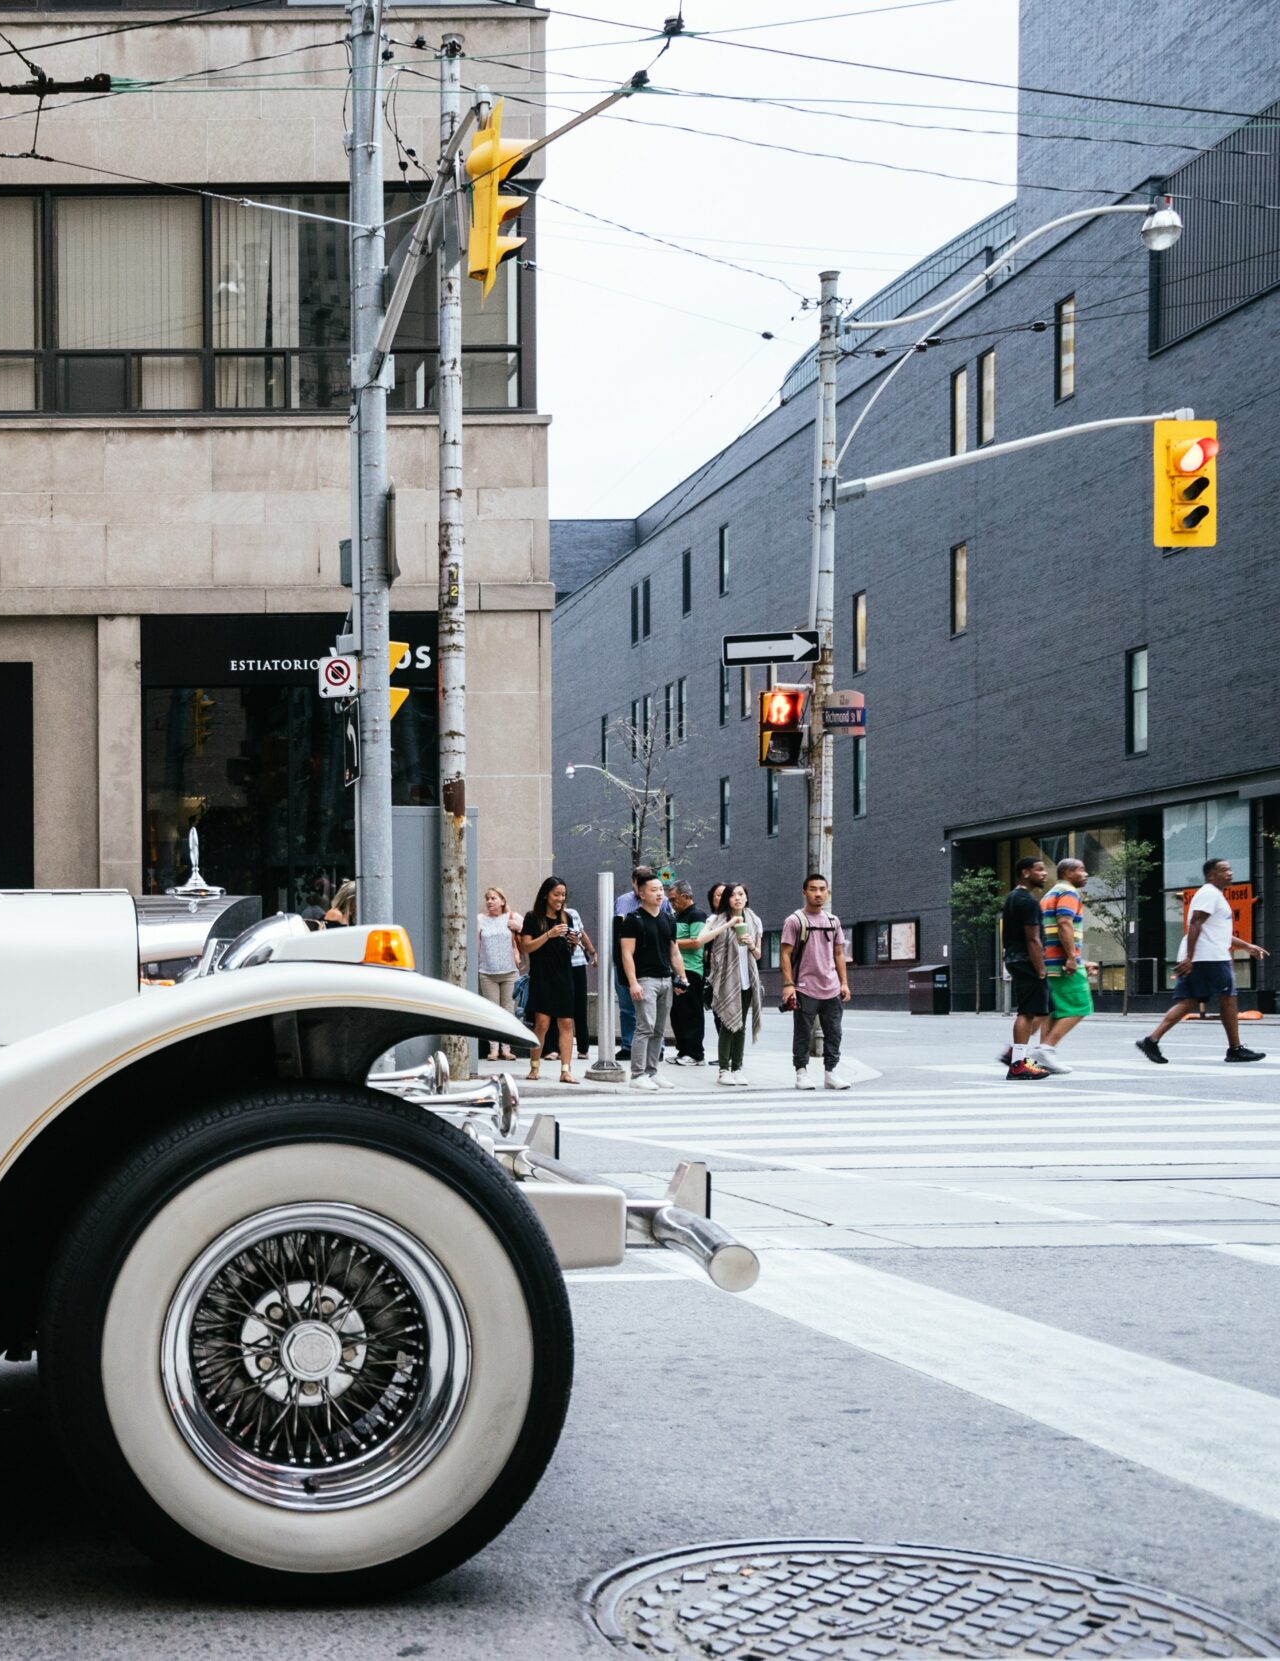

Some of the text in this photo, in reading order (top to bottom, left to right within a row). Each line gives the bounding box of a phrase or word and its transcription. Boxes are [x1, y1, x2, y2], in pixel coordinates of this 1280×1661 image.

[230, 659, 320, 671] ESTIATORIO
[825, 710, 850, 723] Richmond
[1223, 885, 1248, 900] Closed
